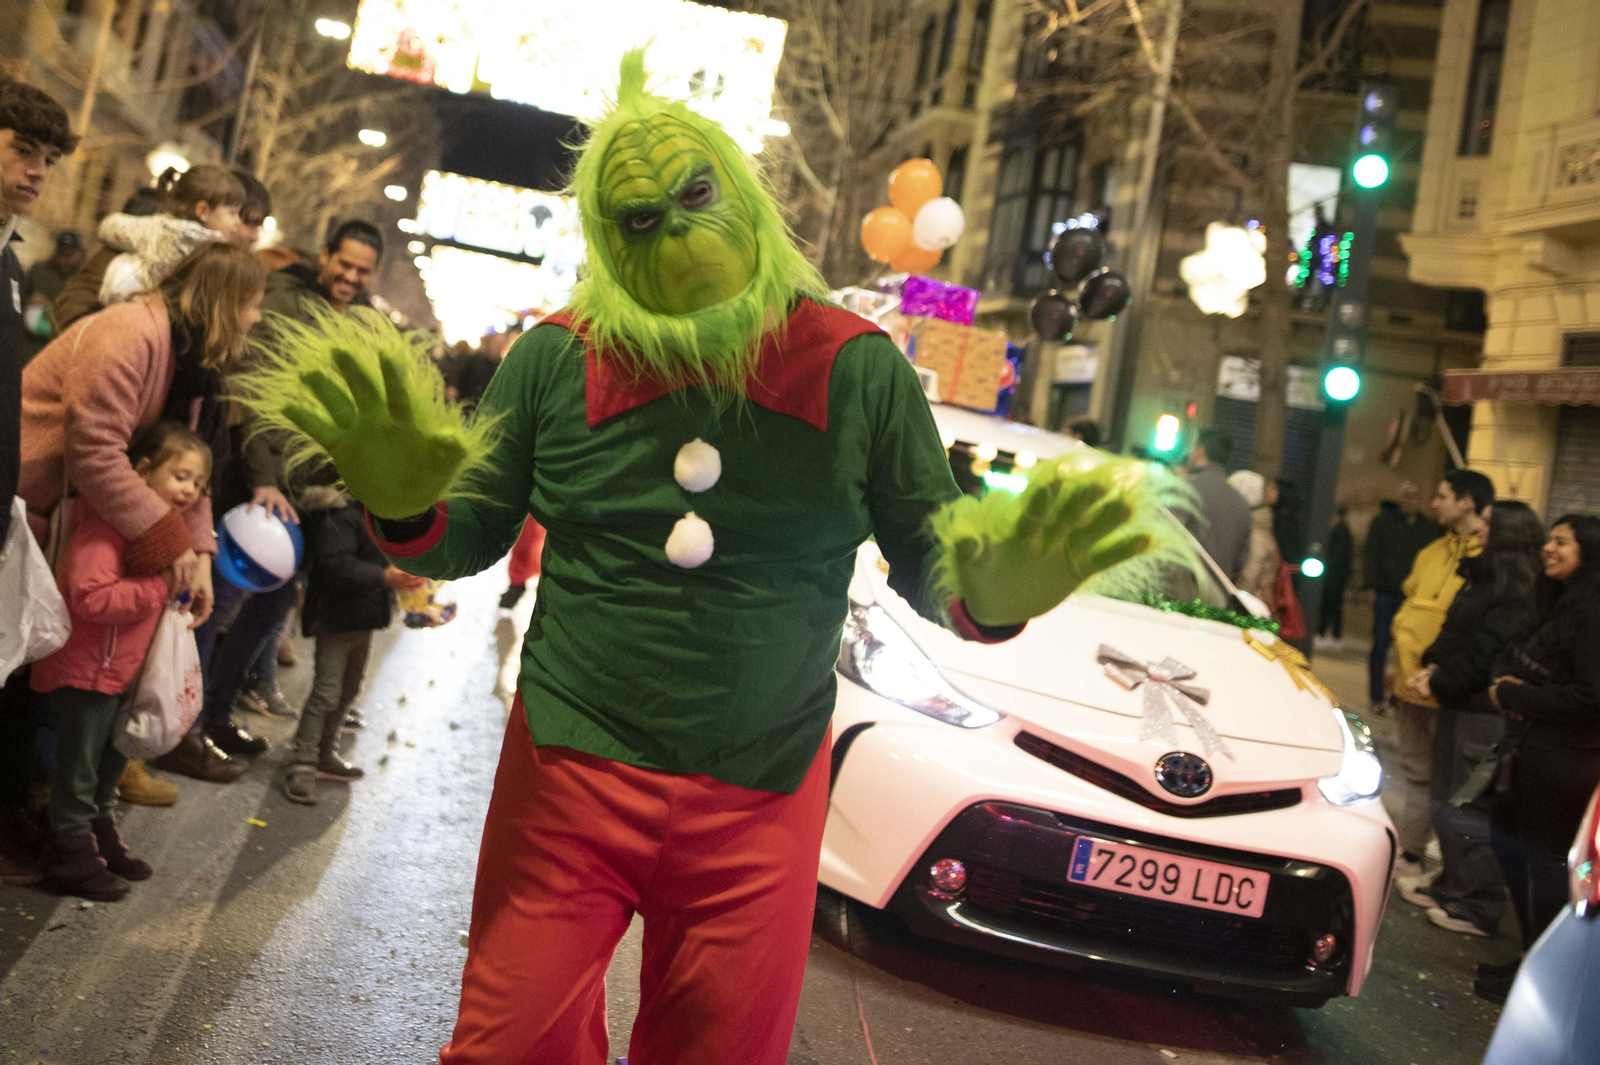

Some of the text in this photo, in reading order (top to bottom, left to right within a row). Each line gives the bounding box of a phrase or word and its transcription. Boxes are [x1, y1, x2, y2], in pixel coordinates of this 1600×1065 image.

[1075, 863, 1086, 874] E
[1092, 849, 1255, 909] 7299 LDC
